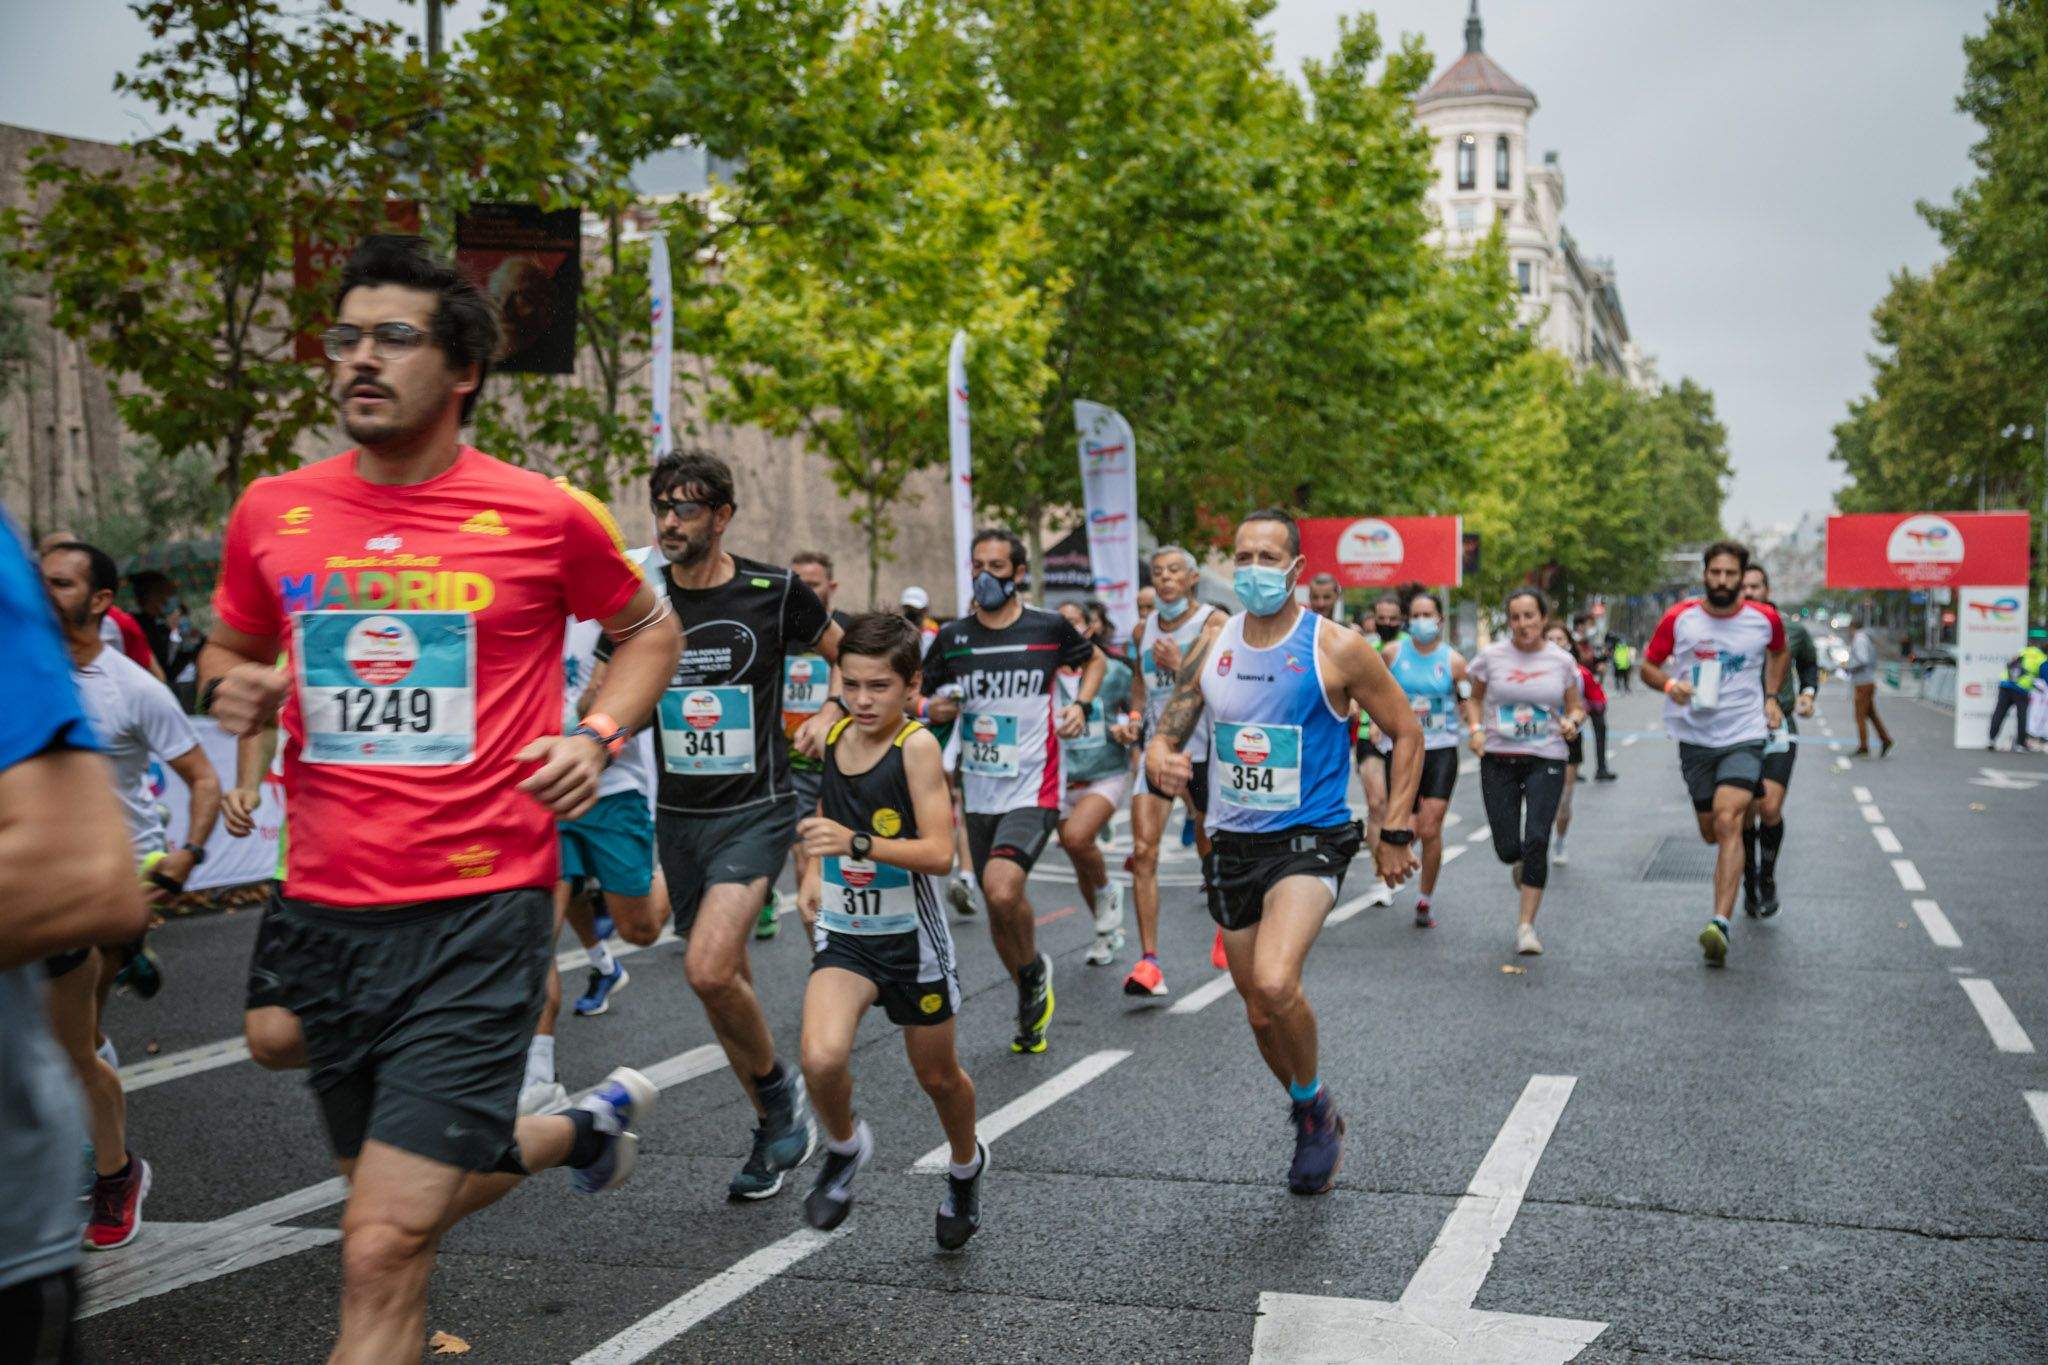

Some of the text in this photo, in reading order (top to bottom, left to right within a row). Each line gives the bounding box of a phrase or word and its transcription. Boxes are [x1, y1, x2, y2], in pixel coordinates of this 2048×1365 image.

[281, 570, 496, 613] MADRID
[333, 688, 432, 733] 1249
[685, 731, 726, 756] 341
[973, 742, 999, 763] 325
[1232, 765, 1274, 792] 354
[843, 888, 881, 915] 317
